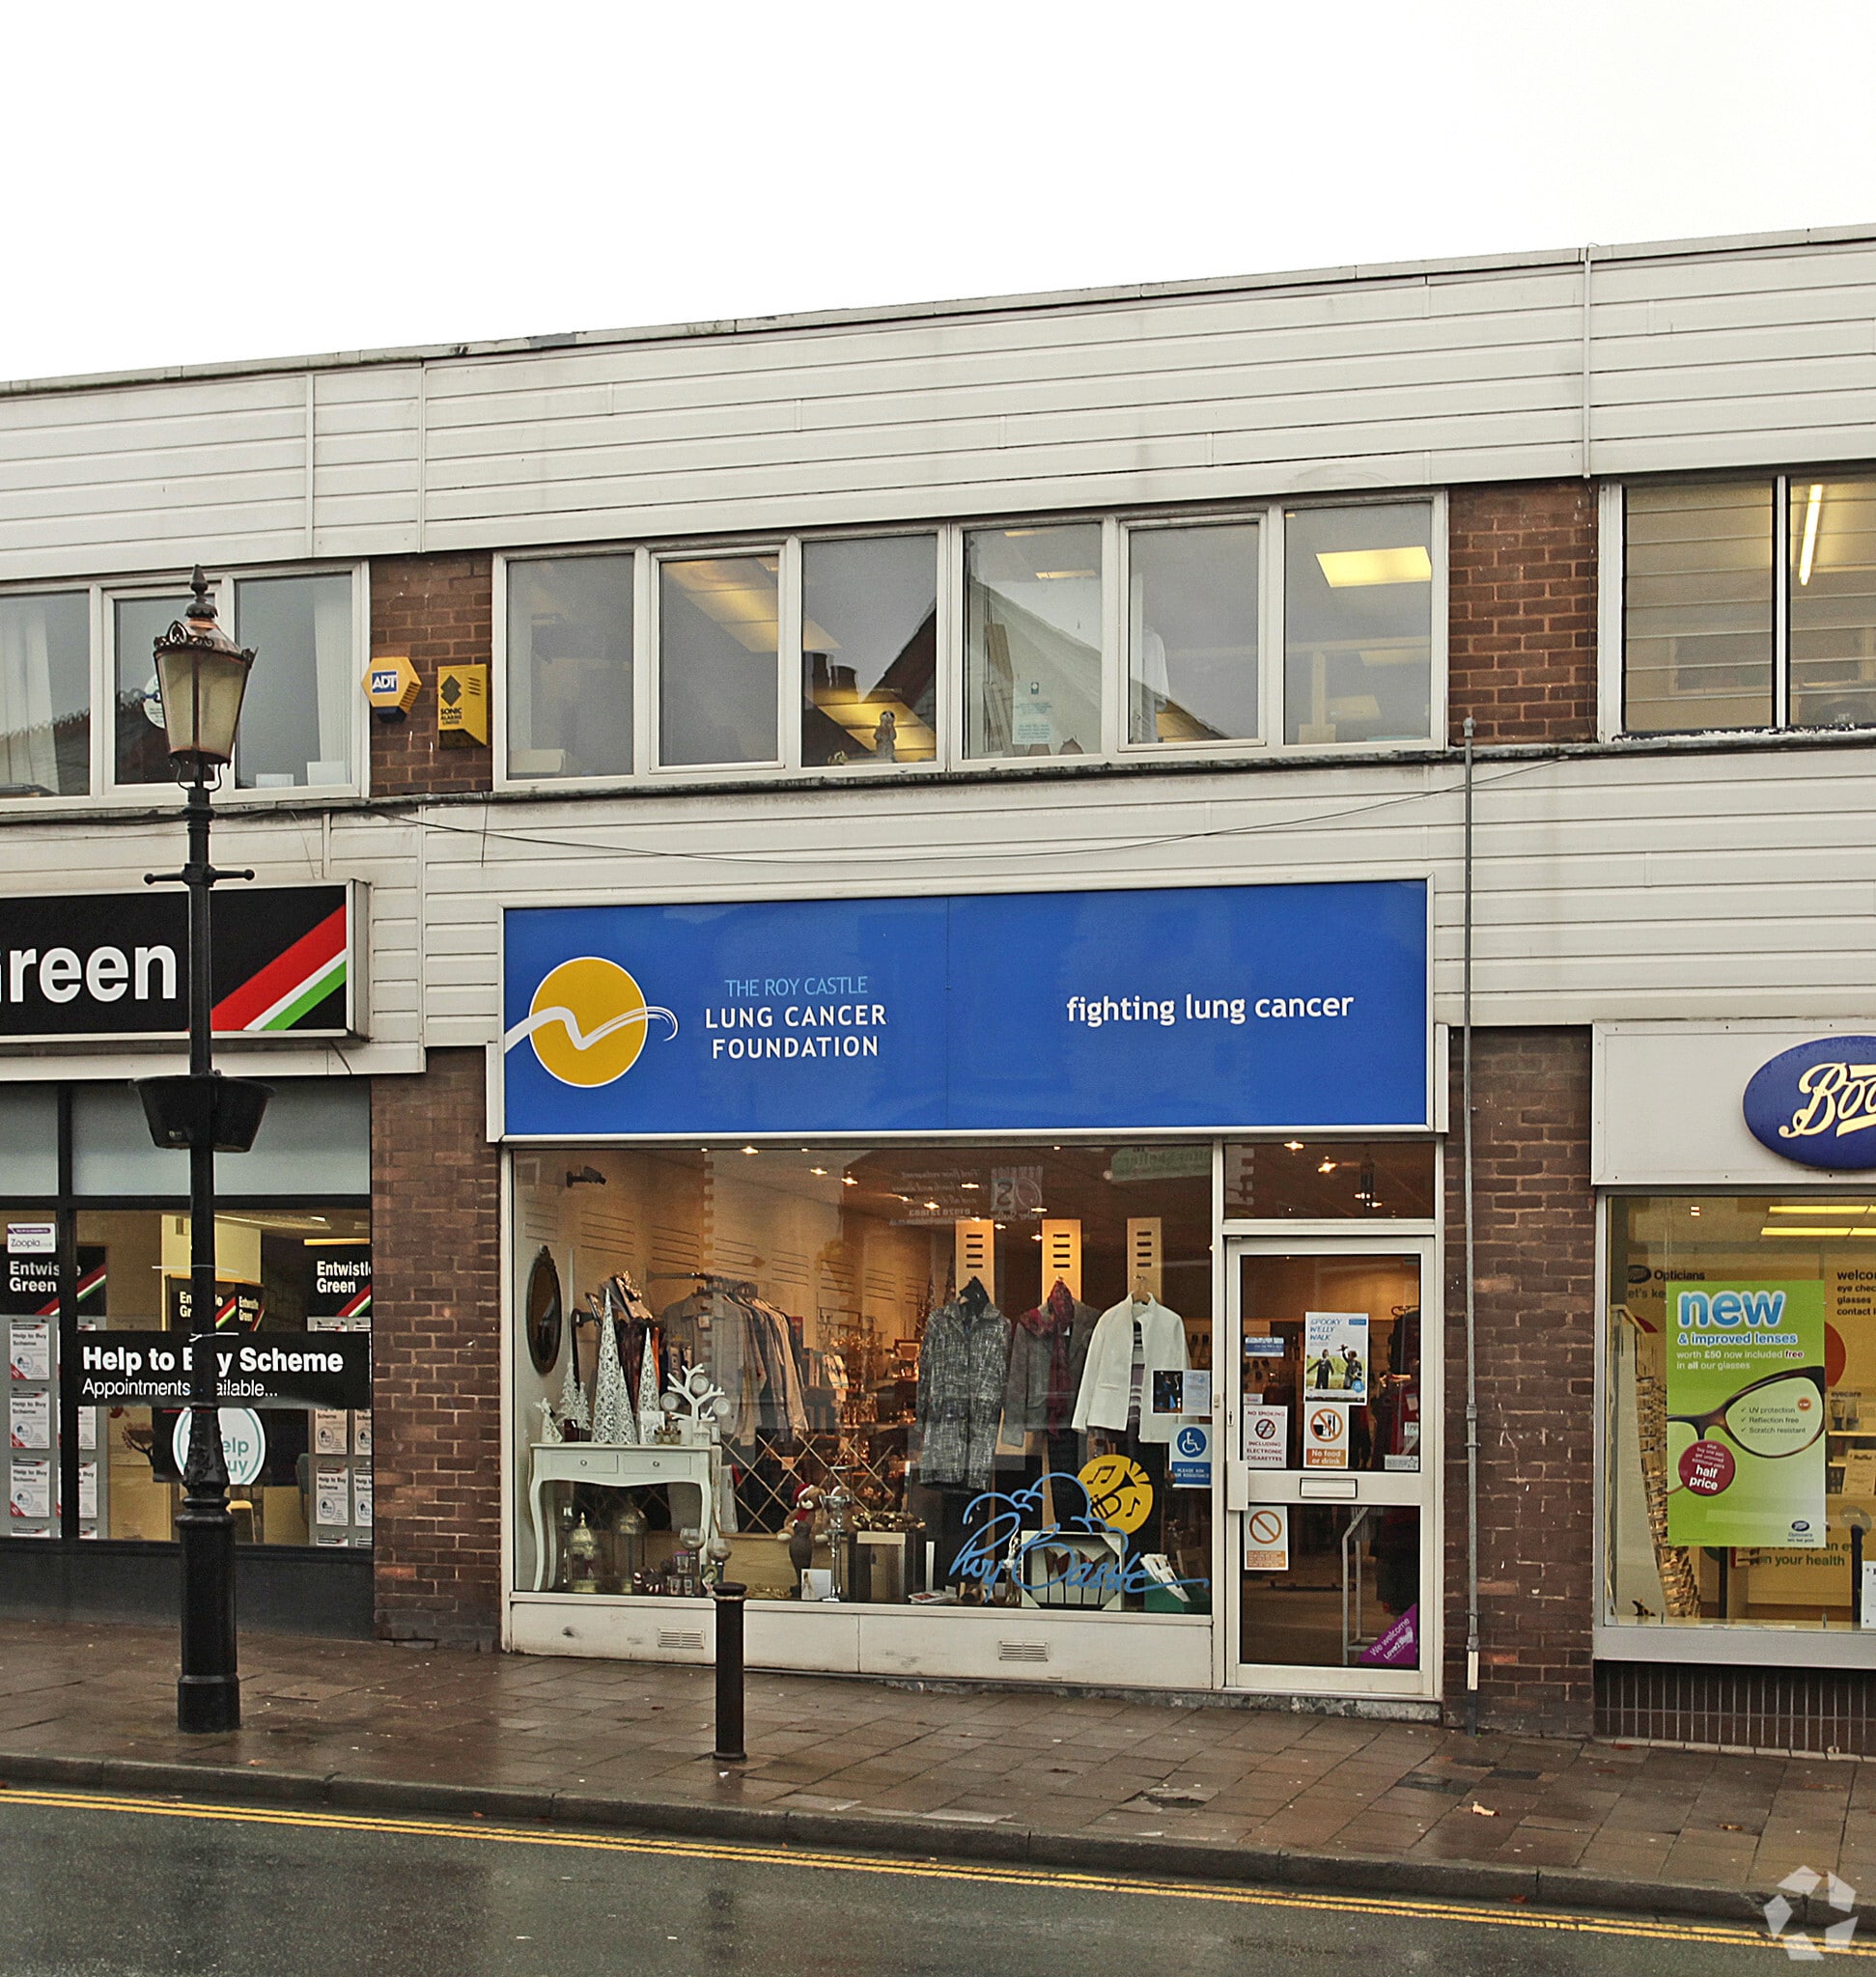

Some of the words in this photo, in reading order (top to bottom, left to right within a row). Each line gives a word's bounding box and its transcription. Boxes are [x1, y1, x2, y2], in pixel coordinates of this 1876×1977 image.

[372, 676, 397, 689] ADT
[0, 945, 177, 1003] reen
[725, 979, 760, 997] THE
[765, 978, 800, 996] ROY
[804, 976, 868, 995] CASTLE
[705, 1006, 773, 1029] LUNG
[784, 1004, 887, 1027] CANCER
[1066, 995, 1176, 1027] fighting
[1185, 993, 1246, 1025] lung
[1255, 996, 1354, 1018] cancer
[712, 1035, 879, 1060] FOUNDATION
[317, 1261, 371, 1276] Entwistl
[1654, 1269, 1705, 1281] Opticians
[10, 1277, 57, 1292] Green
[317, 1277, 356, 1294] Green
[1837, 1295, 1871, 1305] glasses
[1680, 1292, 1784, 1327] new
[1678, 1333, 1688, 1344] &
[1692, 1333, 1750, 1346] improved
[1755, 1333, 1797, 1344] lenses
[83, 1347, 143, 1376] Help
[149, 1349, 175, 1371] to
[239, 1348, 344, 1373] Scheme
[1718, 1362, 1750, 1371] glasses
[82, 1378, 191, 1400] Appointments
[216, 1379, 278, 1397] ailable...
[223, 1436, 249, 1457] elp
[228, 1461, 248, 1476] uy
[1695, 1464, 1718, 1479] half
[1689, 1477, 1718, 1490] price
[948, 1512, 1021, 1602] Roy
[1012, 1522, 1209, 1594] Castle
[1775, 1556, 1803, 1566] your
[1806, 1555, 1845, 1566] health
[1369, 1644, 1383, 1656] We
